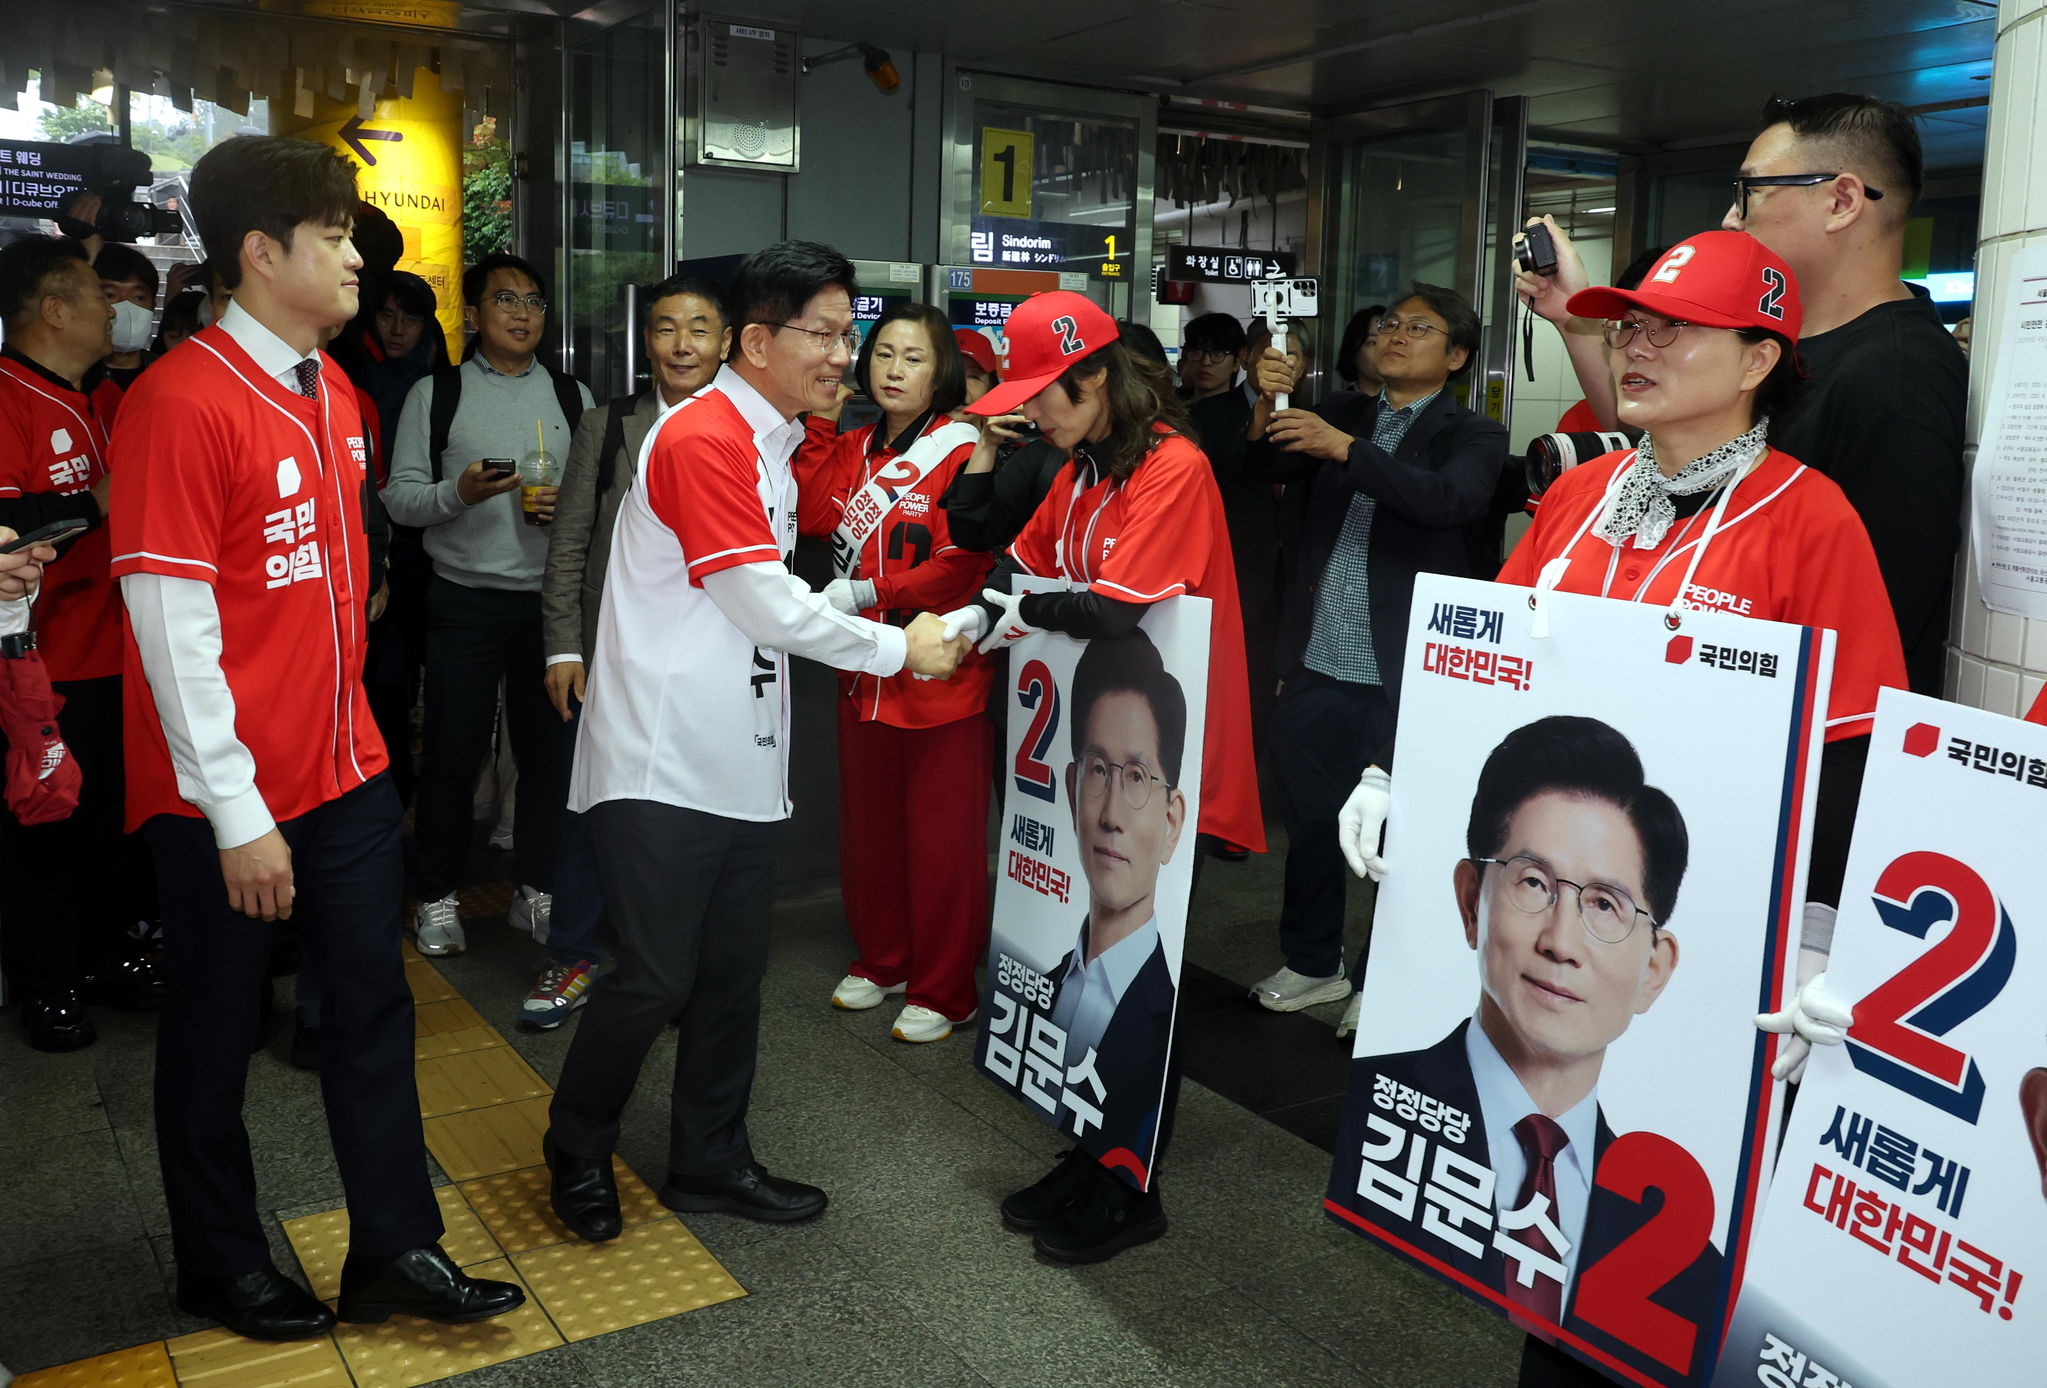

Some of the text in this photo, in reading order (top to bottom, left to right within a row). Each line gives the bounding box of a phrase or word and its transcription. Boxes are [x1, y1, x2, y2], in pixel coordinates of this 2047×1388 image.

[961, 79, 970, 88] 13
[4, 168, 82, 182] THE SAINT WEDDING
[16, 151, 41, 166] 웨딩
[993, 145, 1015, 202] 1
[12, 198, 42, 207] D-cube
[365, 191, 444, 212] HYUNDAI
[971, 232, 994, 262] 림
[1002, 235, 1051, 249] Sindorim
[1002, 250, 1030, 263] 新道林
[1104, 235, 1115, 260] 1
[1186, 255, 1218, 269] 화장실
[951, 271, 970, 288] 175
[1651, 245, 1696, 284] 2
[975, 303, 1012, 316] 보증금
[1758, 267, 1786, 321] 2
[1051, 315, 1086, 356] 2
[48, 454, 90, 486] 국민
[873, 461, 920, 504] 2
[899, 501, 929, 513] POWER
[902, 492, 930, 503] PEOPLE
[902, 510, 923, 518] PARTY
[263, 497, 316, 544] 국민
[265, 540, 323, 590] 의힘
[1686, 583, 1753, 615] PEOPLE
[1427, 603, 1504, 644] 새롭게
[1423, 642, 1533, 691] 대한민국!
[1699, 644, 1778, 678] 국민의힘
[1014, 659, 1060, 804] 2
[1948, 737, 2047, 789] 국민의힘
[1010, 813, 1055, 857] 새롭게
[1007, 850, 1071, 904] 대한민국!
[998, 953, 1055, 1010] 정정당당
[1845, 851, 2016, 1126] 2
[984, 990, 1107, 1137] 김문수
[1373, 1073, 1472, 1144] 정정당당
[1819, 1104, 1971, 1219] 새롭게
[1356, 1112, 1572, 1289] 김문수
[1573, 1131, 1715, 1377] 2
[1803, 1162, 2023, 1321] 대한민국!
